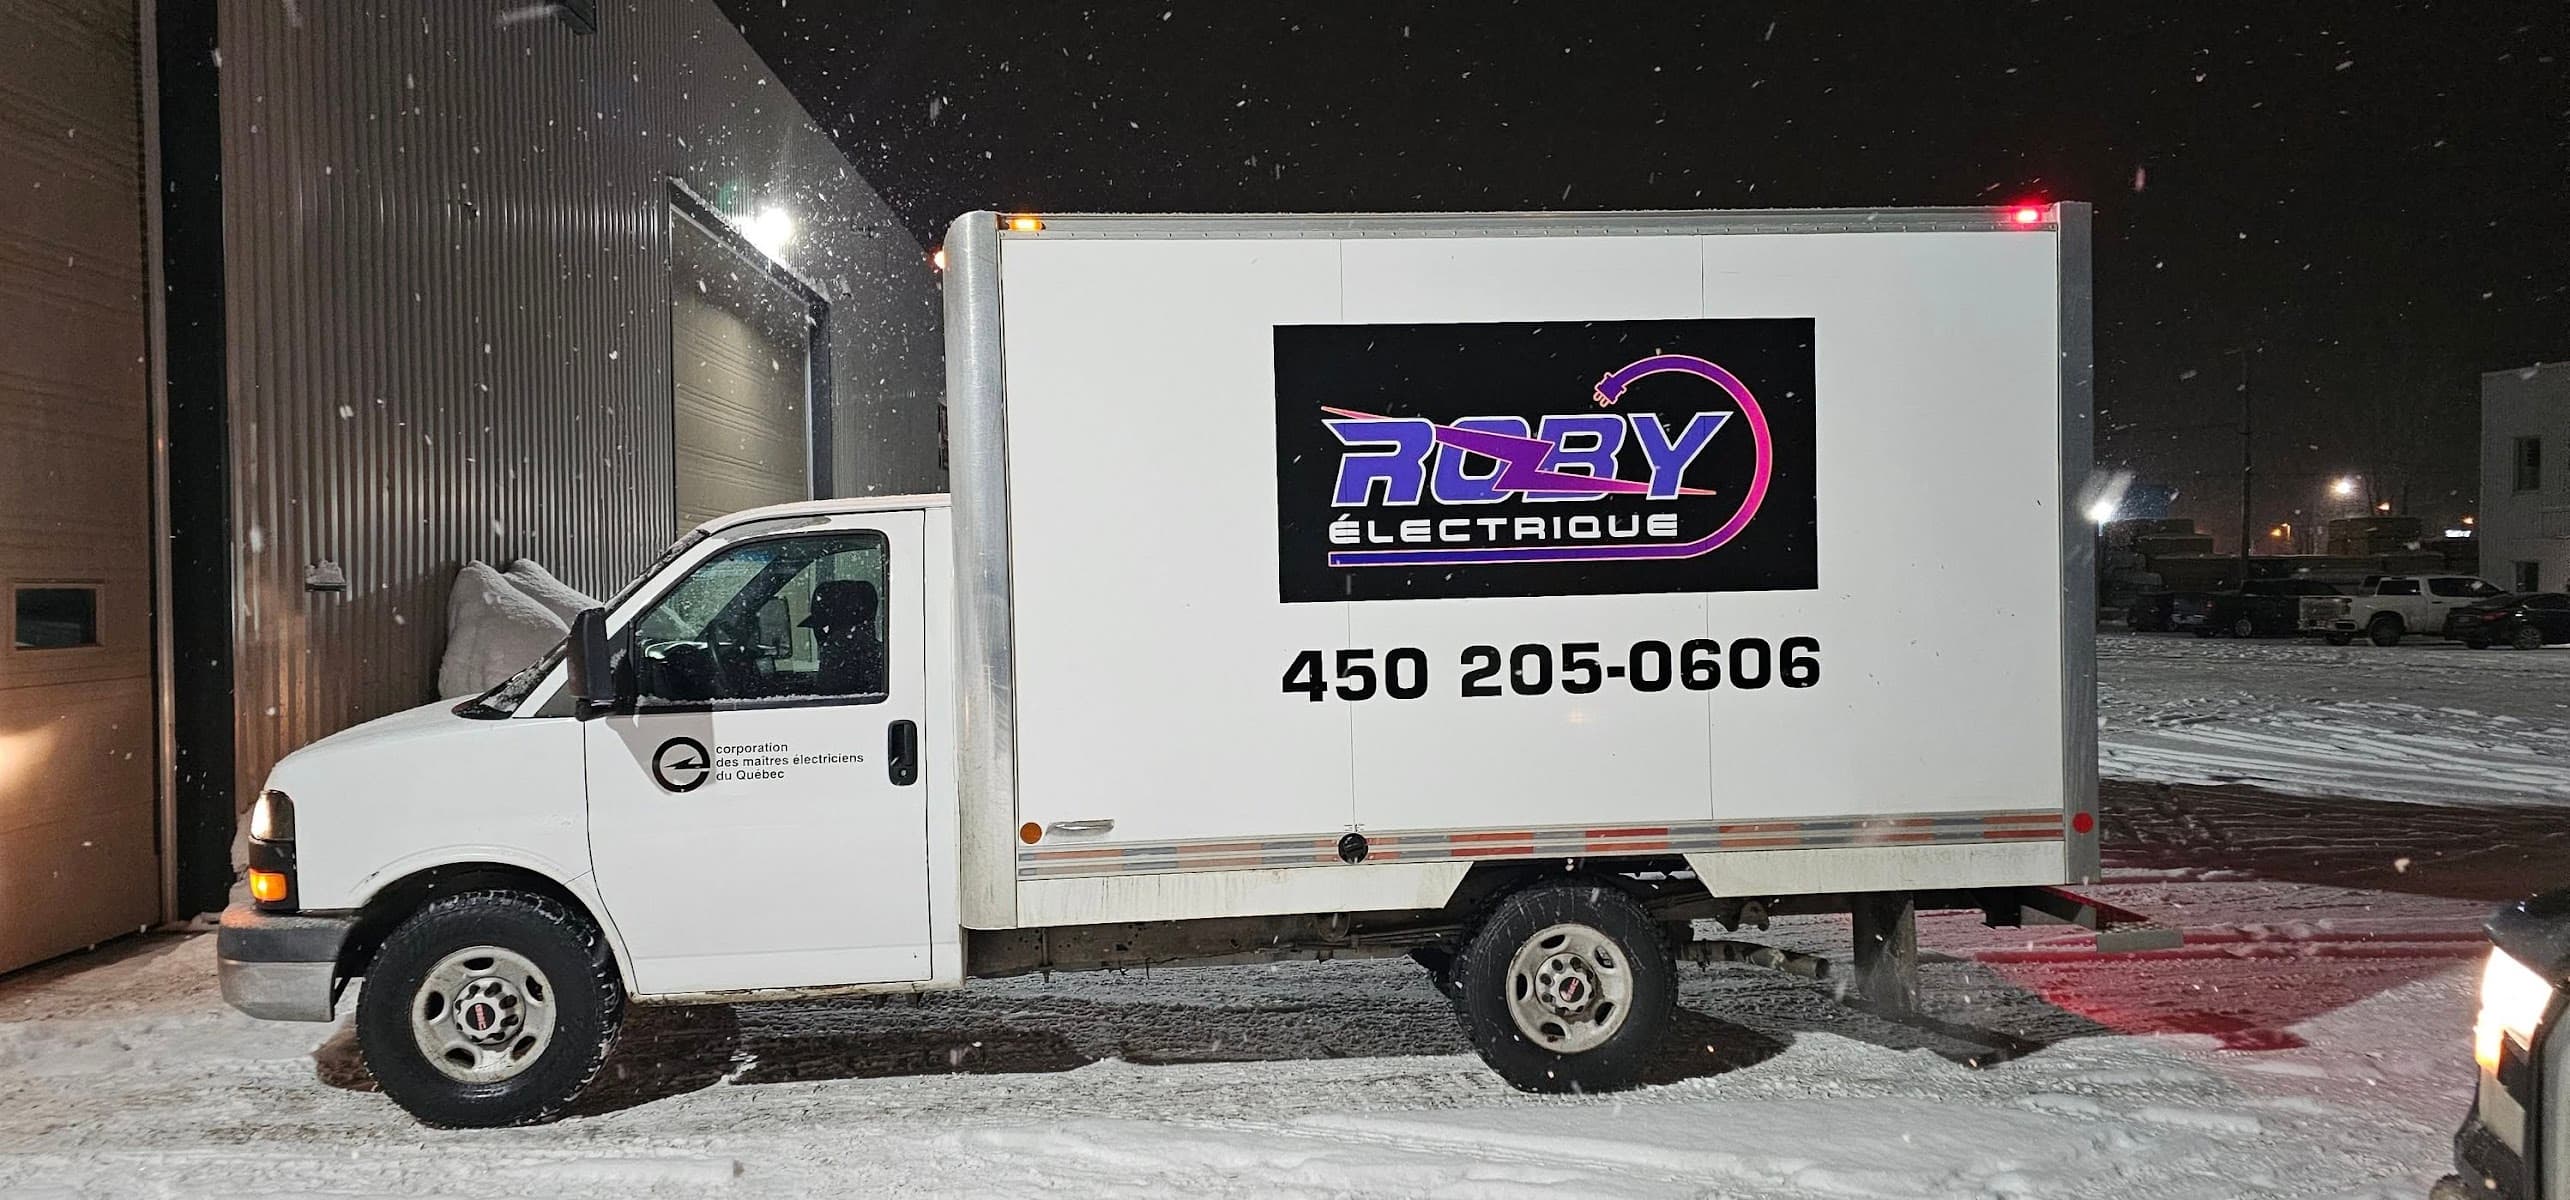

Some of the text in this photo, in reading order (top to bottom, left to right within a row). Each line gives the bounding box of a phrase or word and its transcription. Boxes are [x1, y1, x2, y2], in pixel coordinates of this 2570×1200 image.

[1322, 411, 1733, 507] ROBY
[1328, 513, 1678, 544] ÉLECTRIQUE
[1282, 636, 1821, 702] 450 205-0606
[716, 742, 789, 756] corporation
[716, 757, 739, 767] des
[793, 753, 864, 765] électriciens
[716, 769, 785, 780] du Québec
